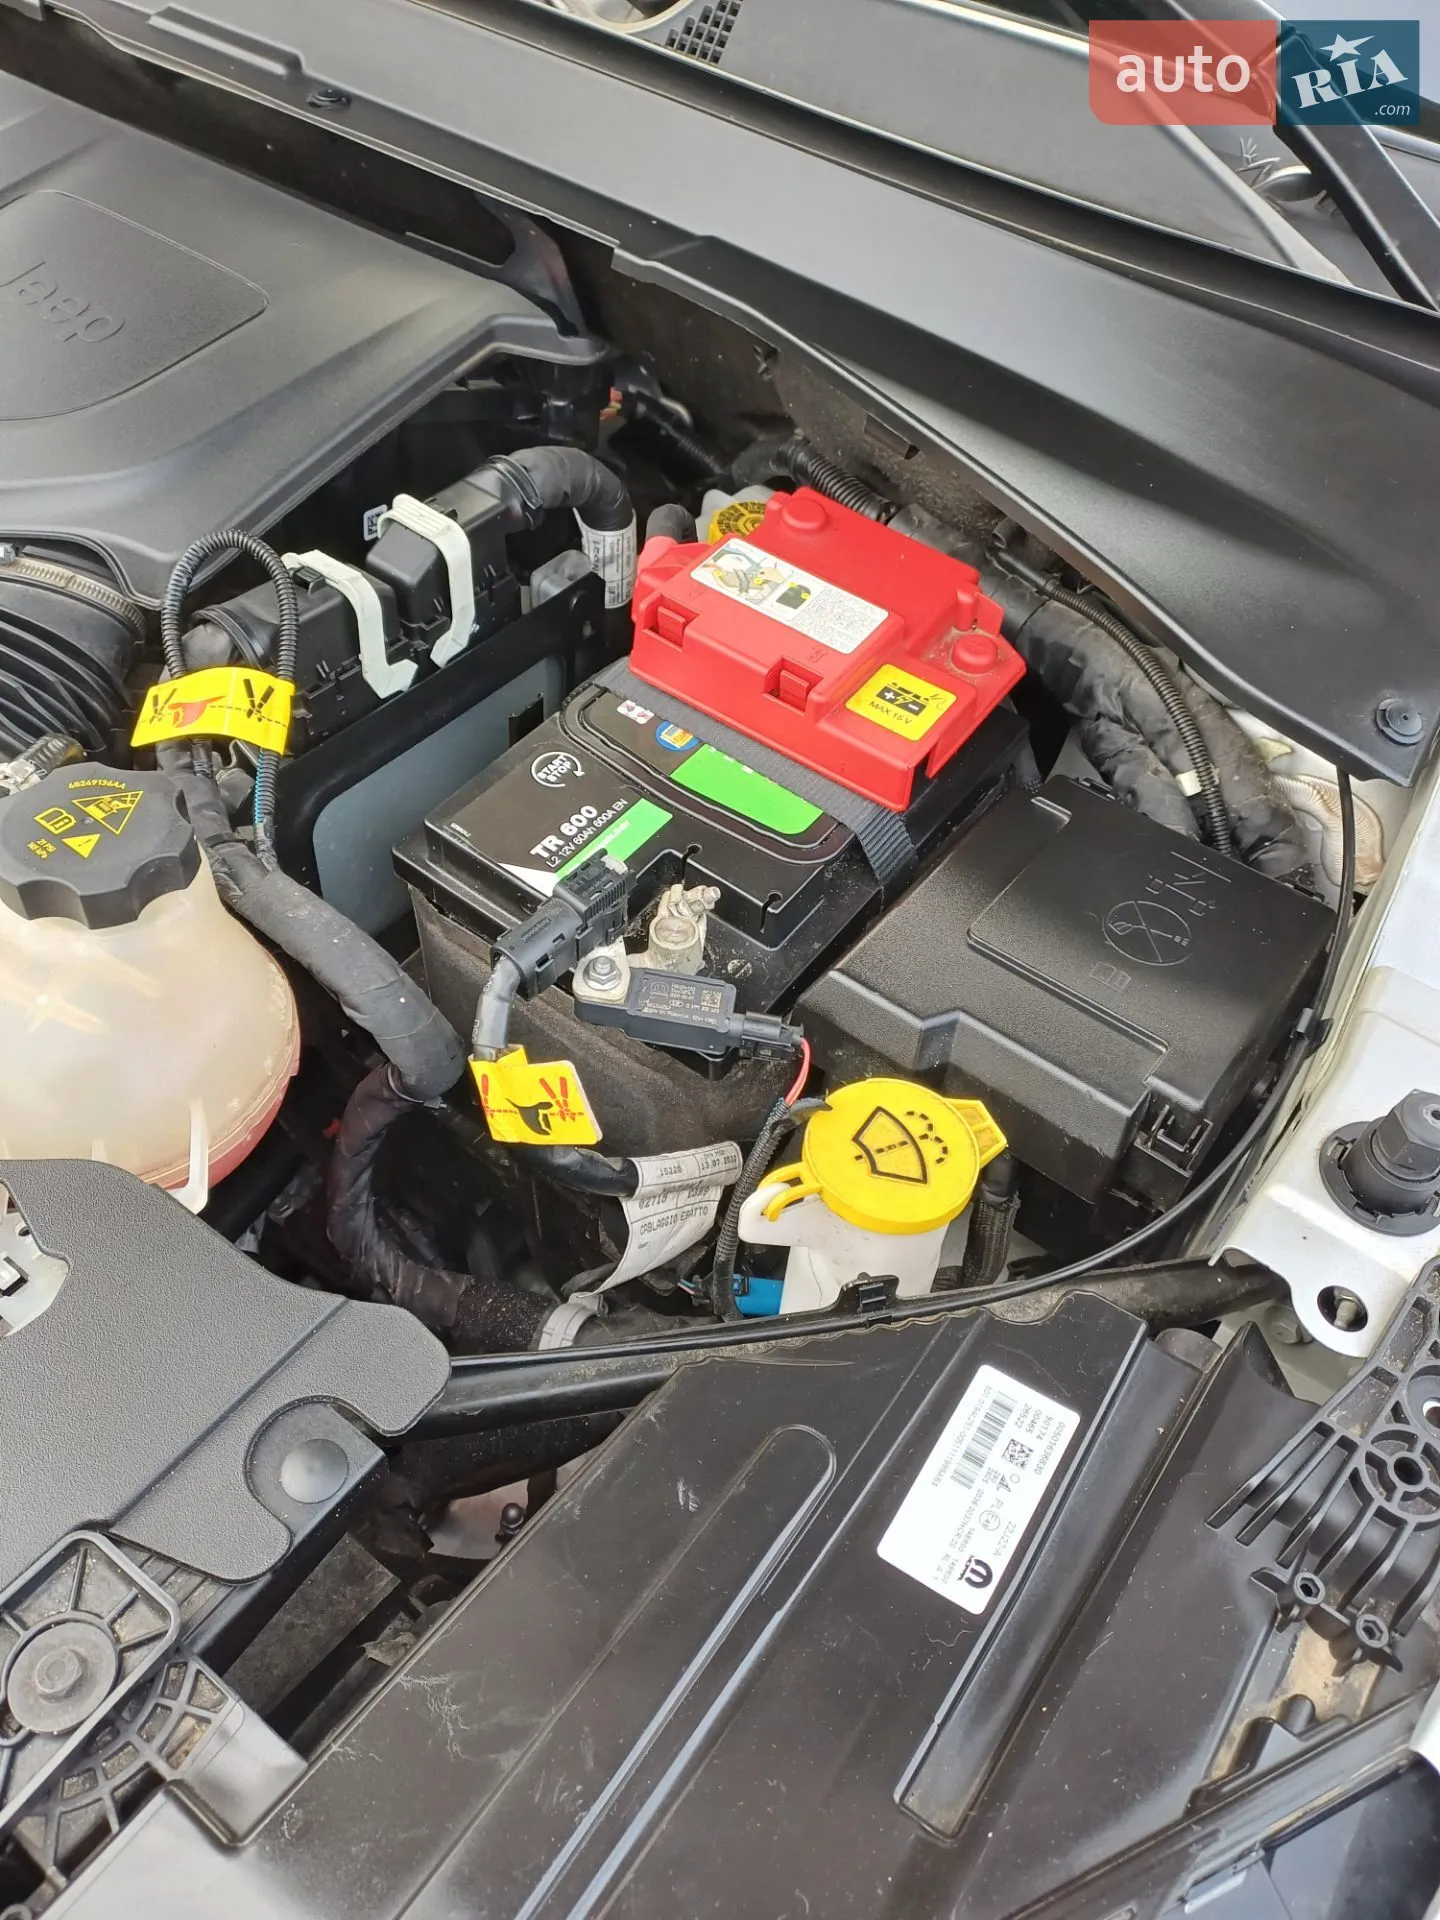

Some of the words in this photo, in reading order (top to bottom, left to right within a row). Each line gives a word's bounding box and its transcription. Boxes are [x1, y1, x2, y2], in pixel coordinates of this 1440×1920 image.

[0, 260, 126, 343] Jeep
[868, 700, 891, 716] MAX
[536, 753, 568, 780] START
[546, 760, 572, 782] STOP
[529, 834, 565, 858] TR
[559, 805, 598, 836] 600
[545, 855, 562, 868] L2
[558, 841, 577, 857] 12V
[572, 825, 597, 844] 60Ah
[592, 810, 617, 828] 600A
[611, 798, 629, 812] EN
